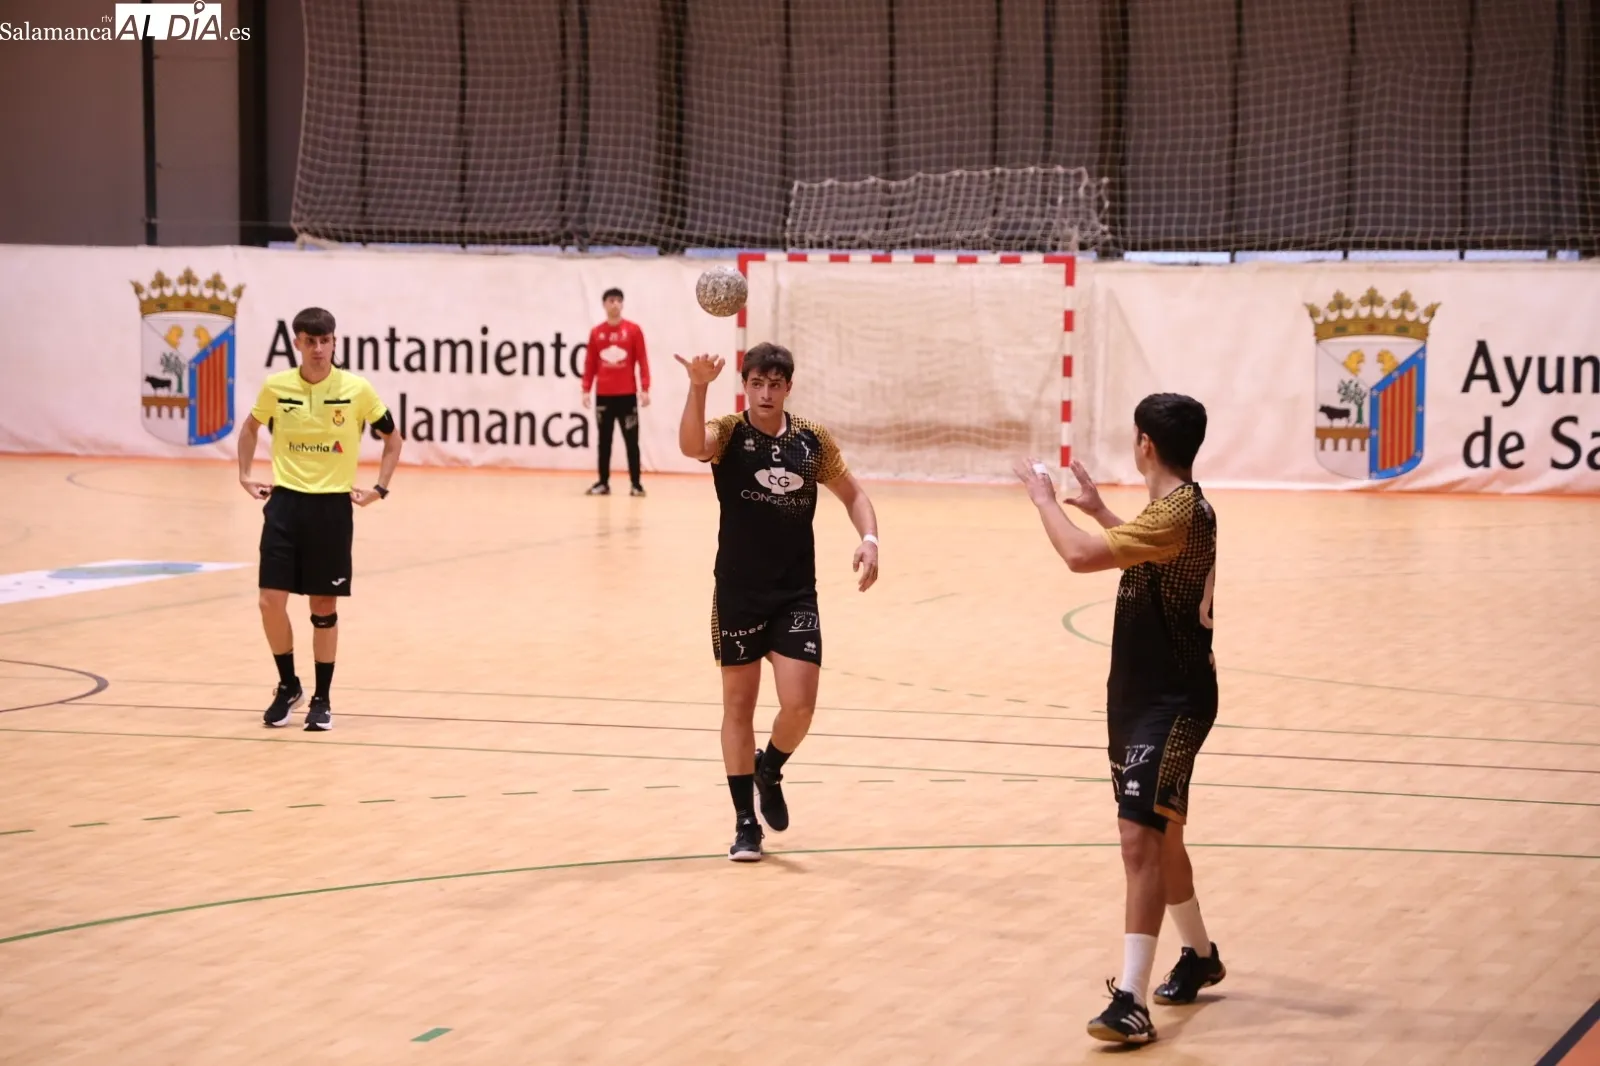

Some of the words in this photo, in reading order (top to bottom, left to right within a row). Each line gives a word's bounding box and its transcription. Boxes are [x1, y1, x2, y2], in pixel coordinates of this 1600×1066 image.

[265, 319, 588, 379] Auntamiento
[1461, 340, 1600, 407] Ayun
[289, 442, 330, 453] helvetia
[361, 393, 589, 449] lamanca
[1463, 416, 1525, 470] de
[771, 445, 782, 462] 2
[768, 475, 790, 488] CG
